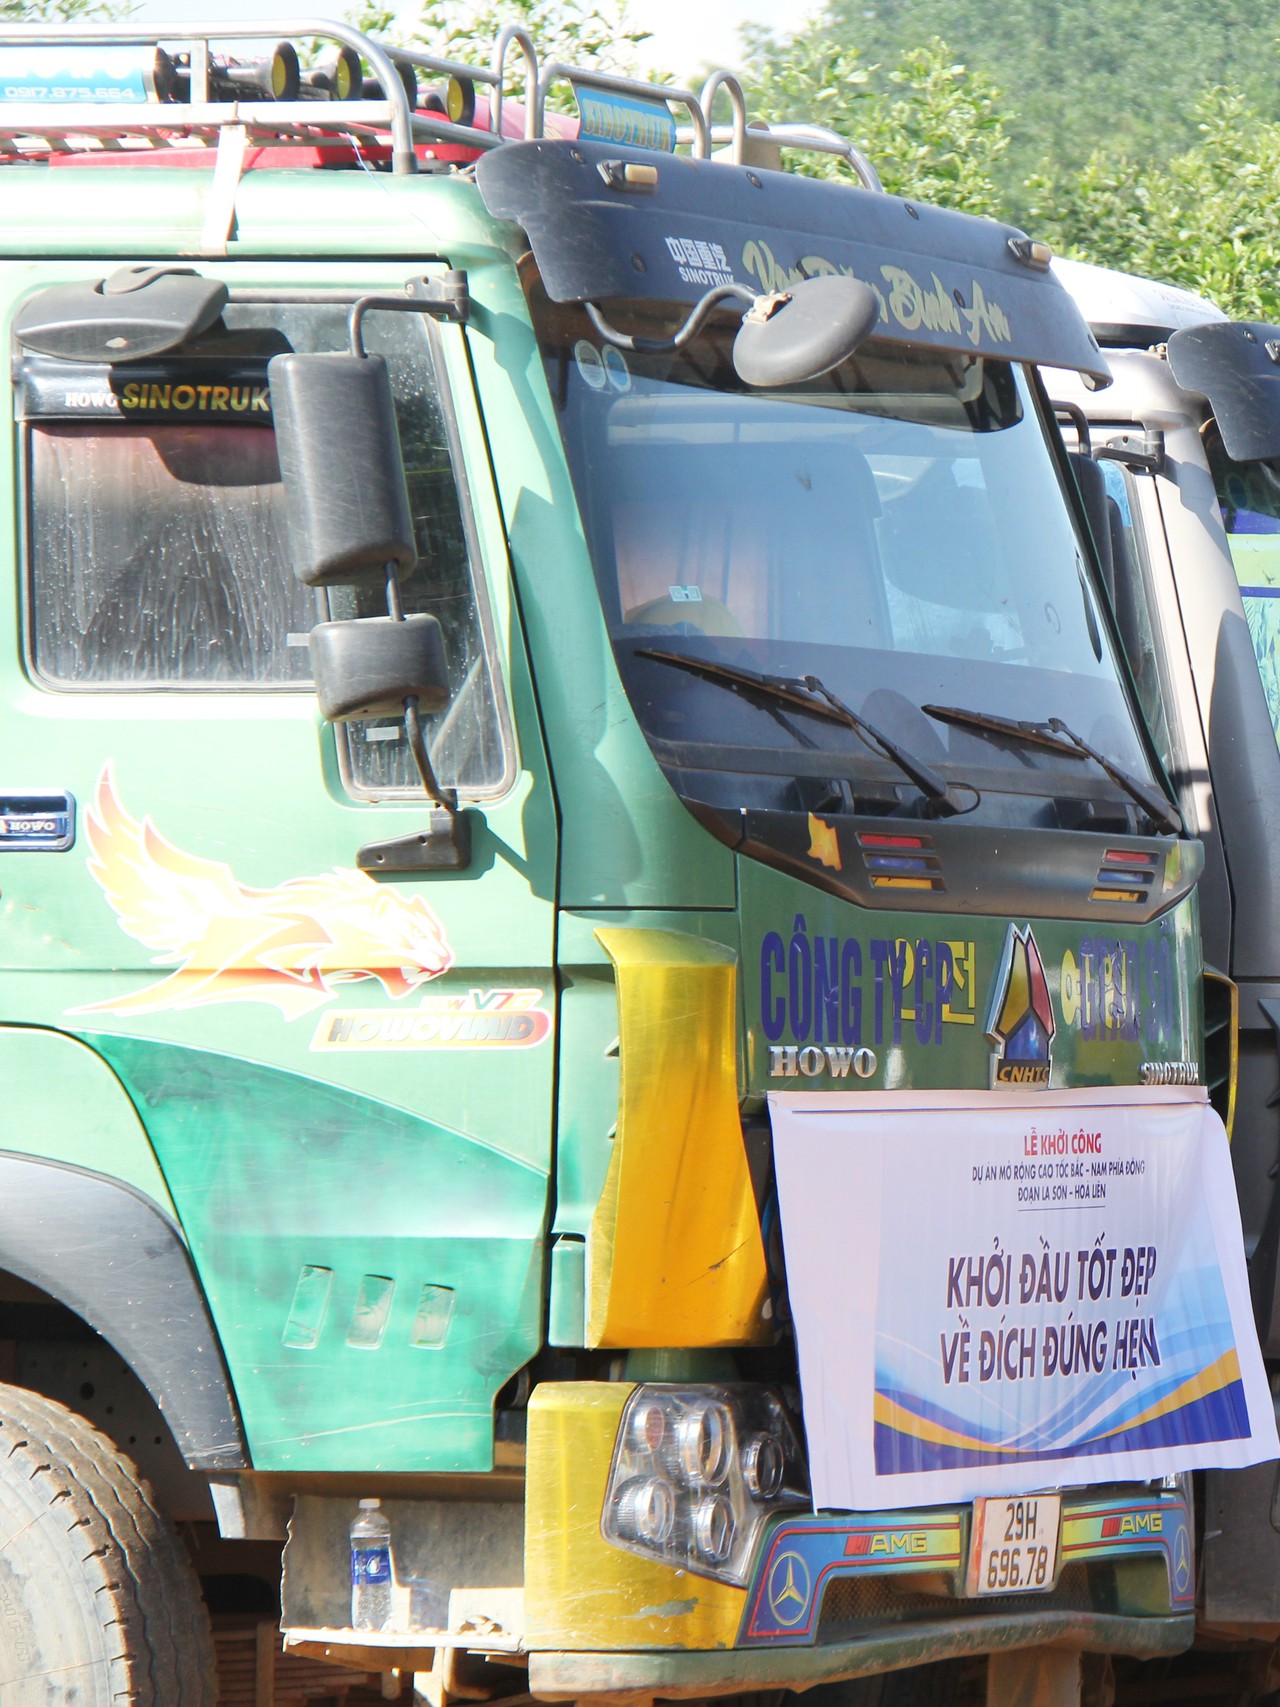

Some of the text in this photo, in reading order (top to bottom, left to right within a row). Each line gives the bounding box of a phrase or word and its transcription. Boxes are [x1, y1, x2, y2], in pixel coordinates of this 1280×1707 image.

[5, 86, 136, 99] 0917.875.664
[583, 98, 671, 153] SINOTRUK
[665, 237, 732, 272] 中国重汽
[122, 383, 270, 412] SINOTRUK
[761, 914, 862, 1045] CÔNG
[769, 1045, 878, 1078] HOWO
[1000, 1066, 1049, 1083] CNHTC
[1024, 1126, 1102, 1156] LỄ KHỞI CÔNG
[1013, 1161, 1036, 1183] RỘNG
[1038, 1163, 1054, 1180] CAO
[1055, 1158, 1069, 1179] TỐC
[1091, 1161, 1107, 1177] NAM
[1108, 1157, 1124, 1176] PHÍA
[1125, 1156, 1145, 1175] ĐÔNG
[1018, 1186, 1040, 1204] ĐOẠN
[1042, 1185, 1051, 1200] LA
[1052, 1184, 1068, 1200] SƠN
[946, 1232, 1157, 1308] KHỞI ĐẦU TỐT ĐẸP
[940, 1311, 1161, 1384] VỀ ĐÍCH ĐÚNG HẸN
[1004, 1500, 1038, 1542] 29H
[1119, 1513, 1163, 1535] AMG
[870, 1533, 928, 1554] AMG
[986, 1545, 1049, 1589] 696.78
